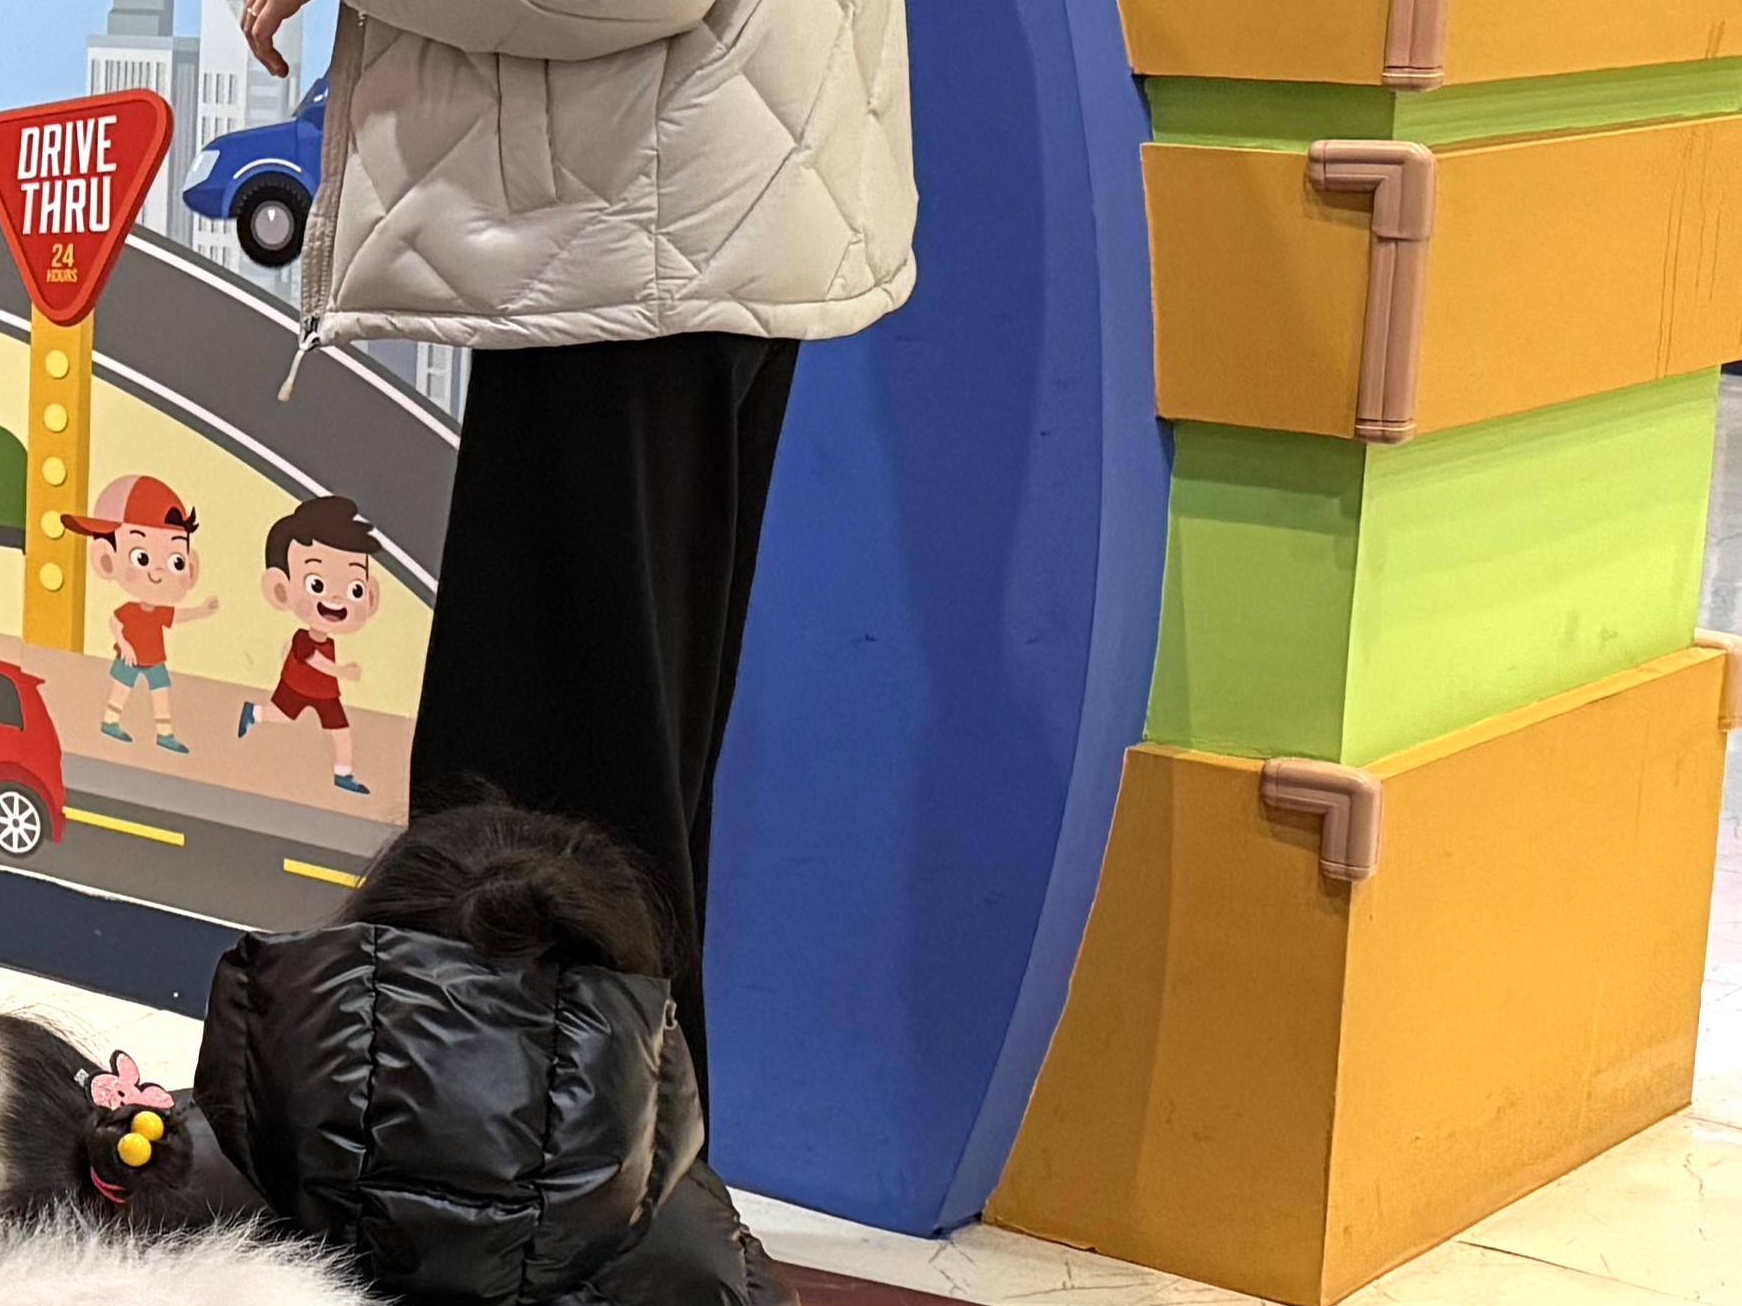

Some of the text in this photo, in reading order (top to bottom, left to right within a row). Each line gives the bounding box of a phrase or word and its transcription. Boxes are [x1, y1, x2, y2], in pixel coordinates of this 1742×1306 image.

[17, 115, 117, 179] DRIVE
[21, 176, 111, 235] THRU
[51, 243, 74, 268] 24
